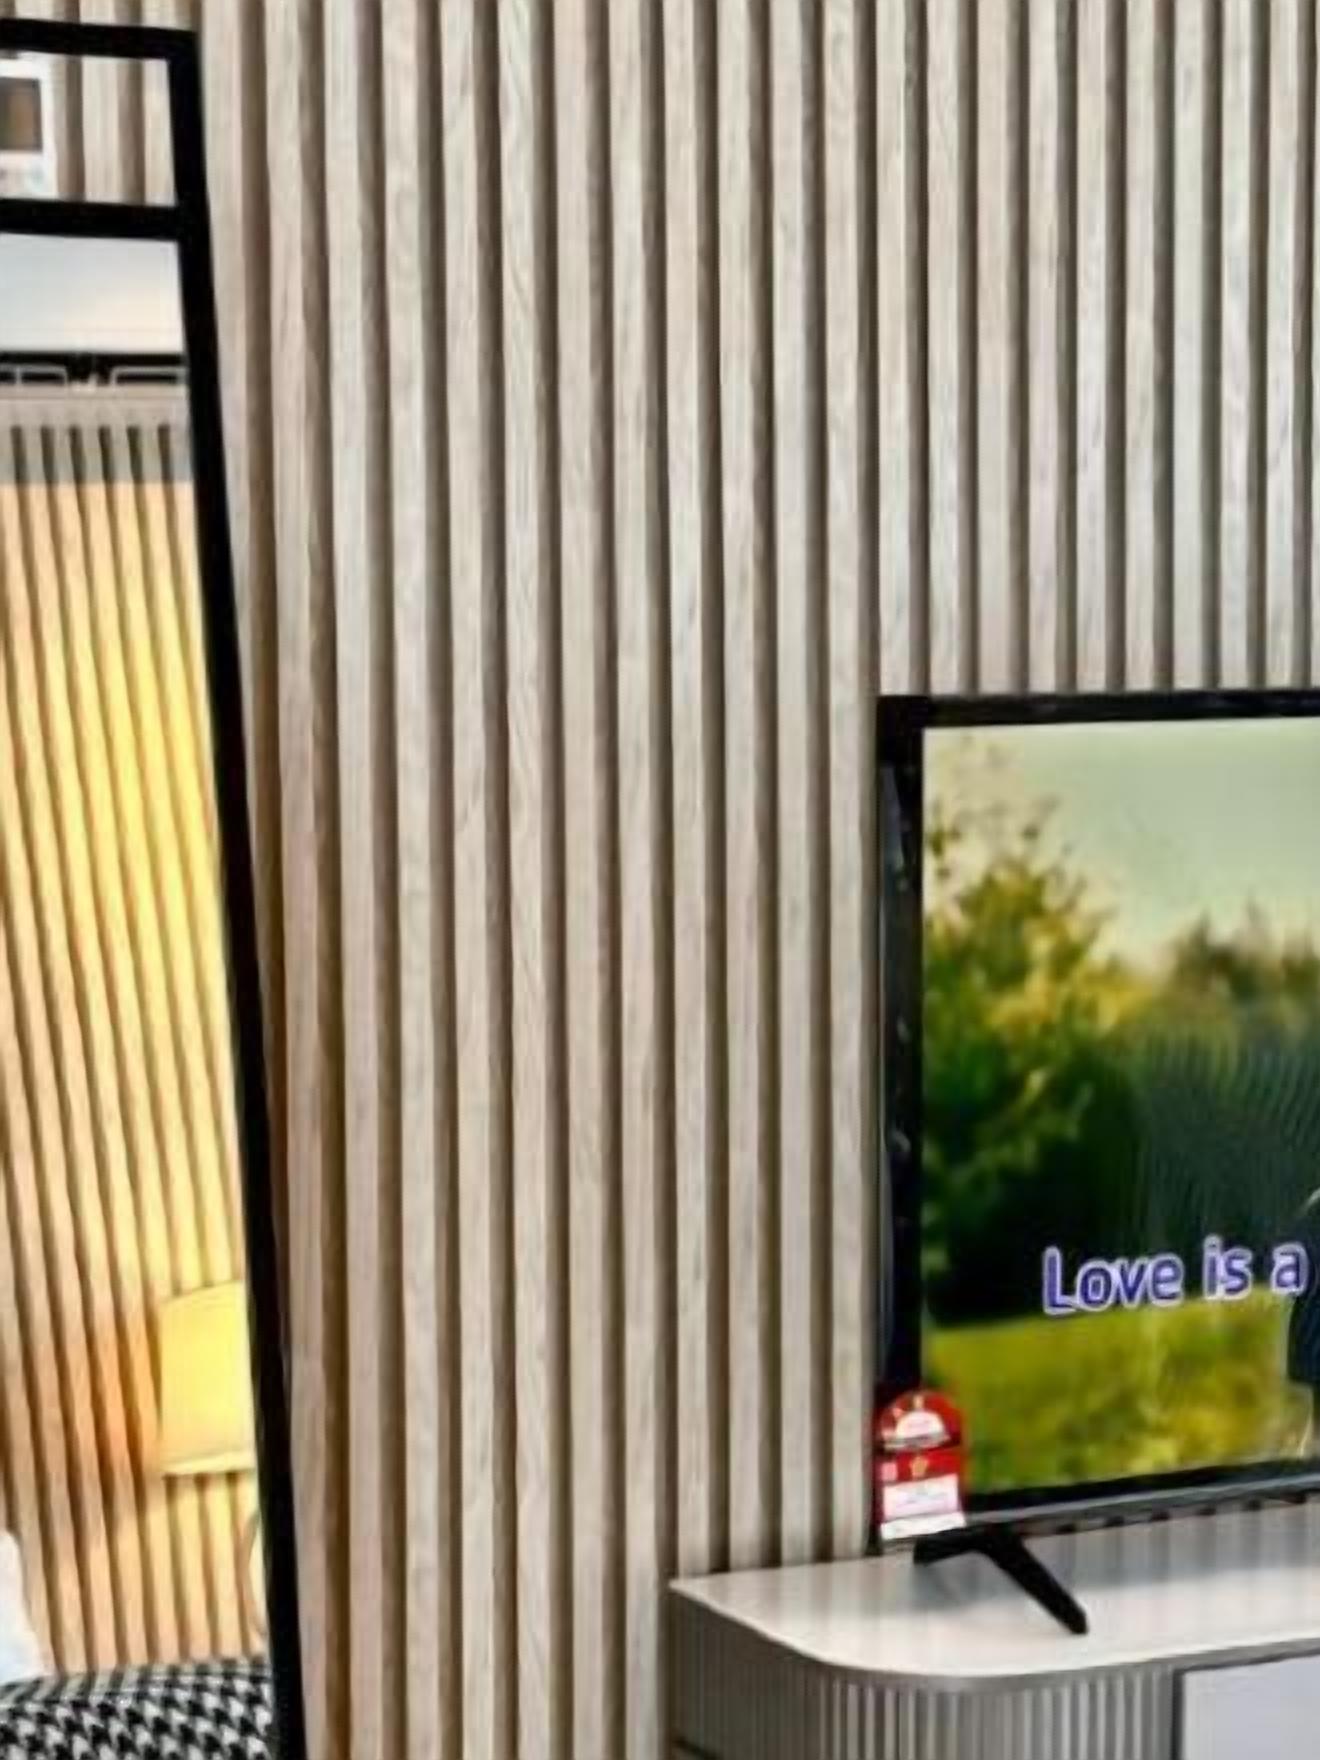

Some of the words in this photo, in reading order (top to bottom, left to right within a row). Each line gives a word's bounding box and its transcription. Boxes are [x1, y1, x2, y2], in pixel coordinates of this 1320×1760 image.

[1043, 1245, 1183, 1315] Love
[1202, 1234, 1254, 1299] is
[1271, 1244, 1305, 1296] a
